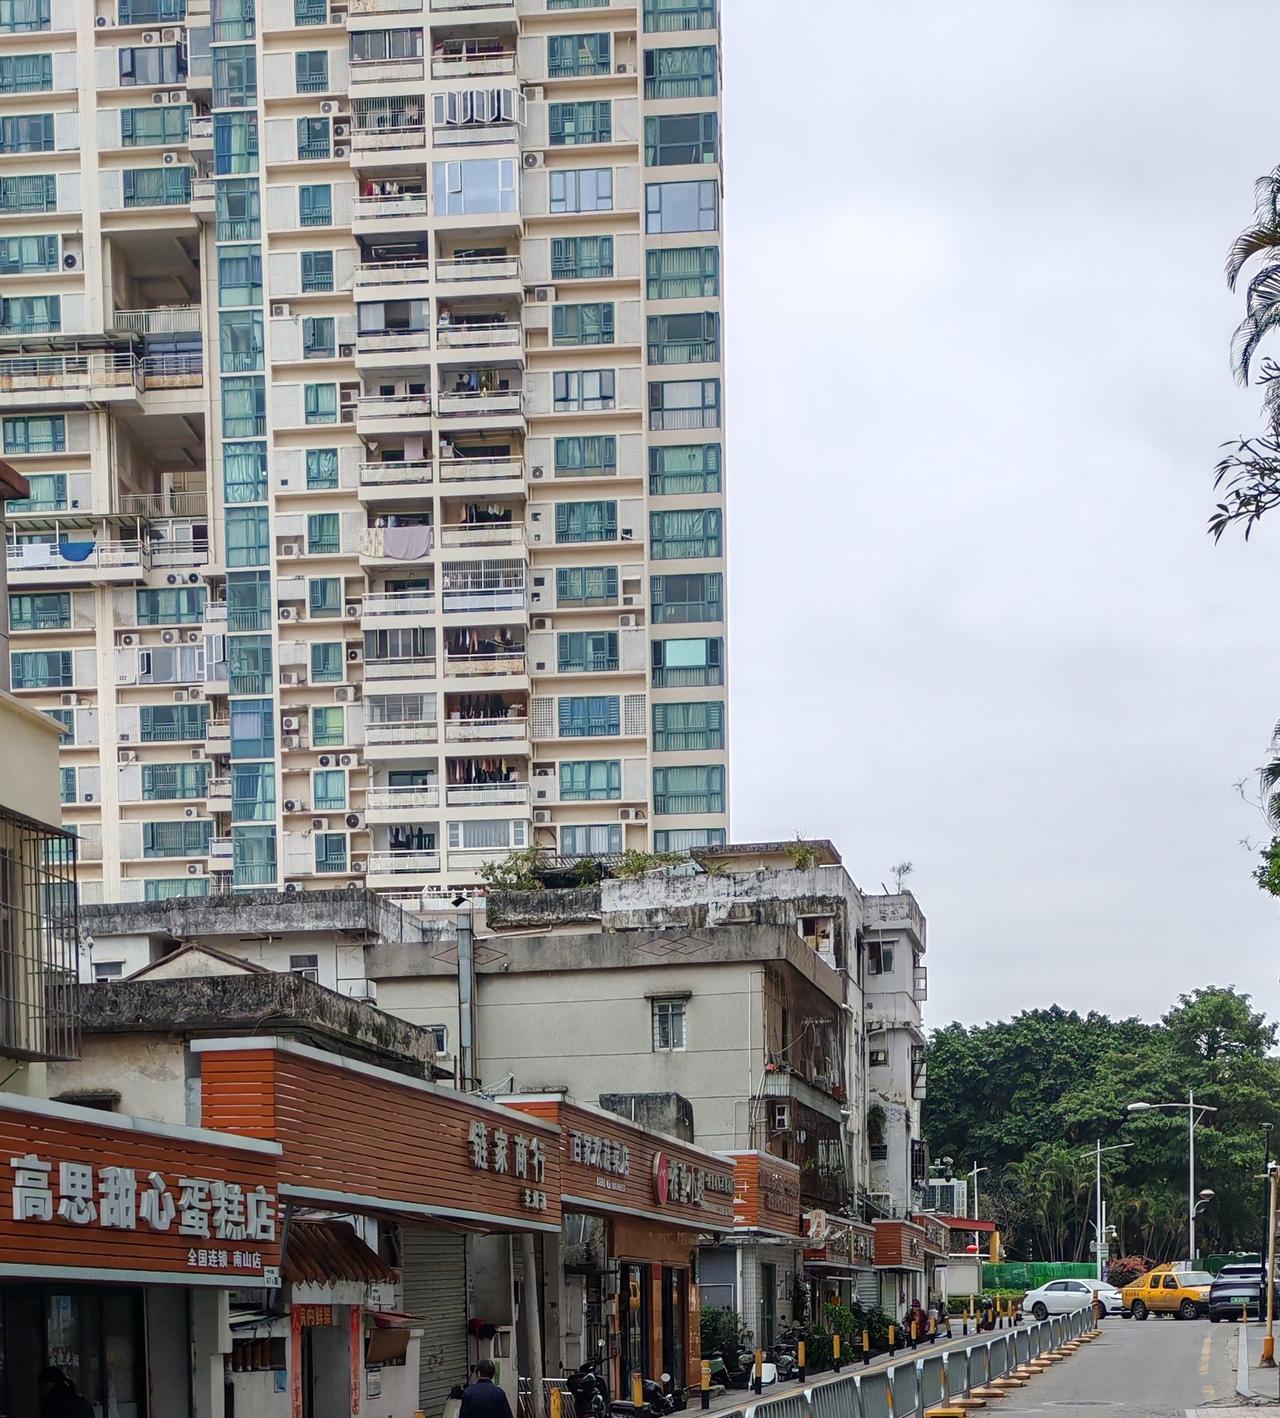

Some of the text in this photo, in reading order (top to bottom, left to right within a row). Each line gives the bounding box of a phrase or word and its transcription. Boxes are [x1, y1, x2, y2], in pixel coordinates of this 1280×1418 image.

[10, 1154, 276, 1241] 高思甜心蛋糕店
[187, 1248, 262, 1269] 全国连锁 南山店
